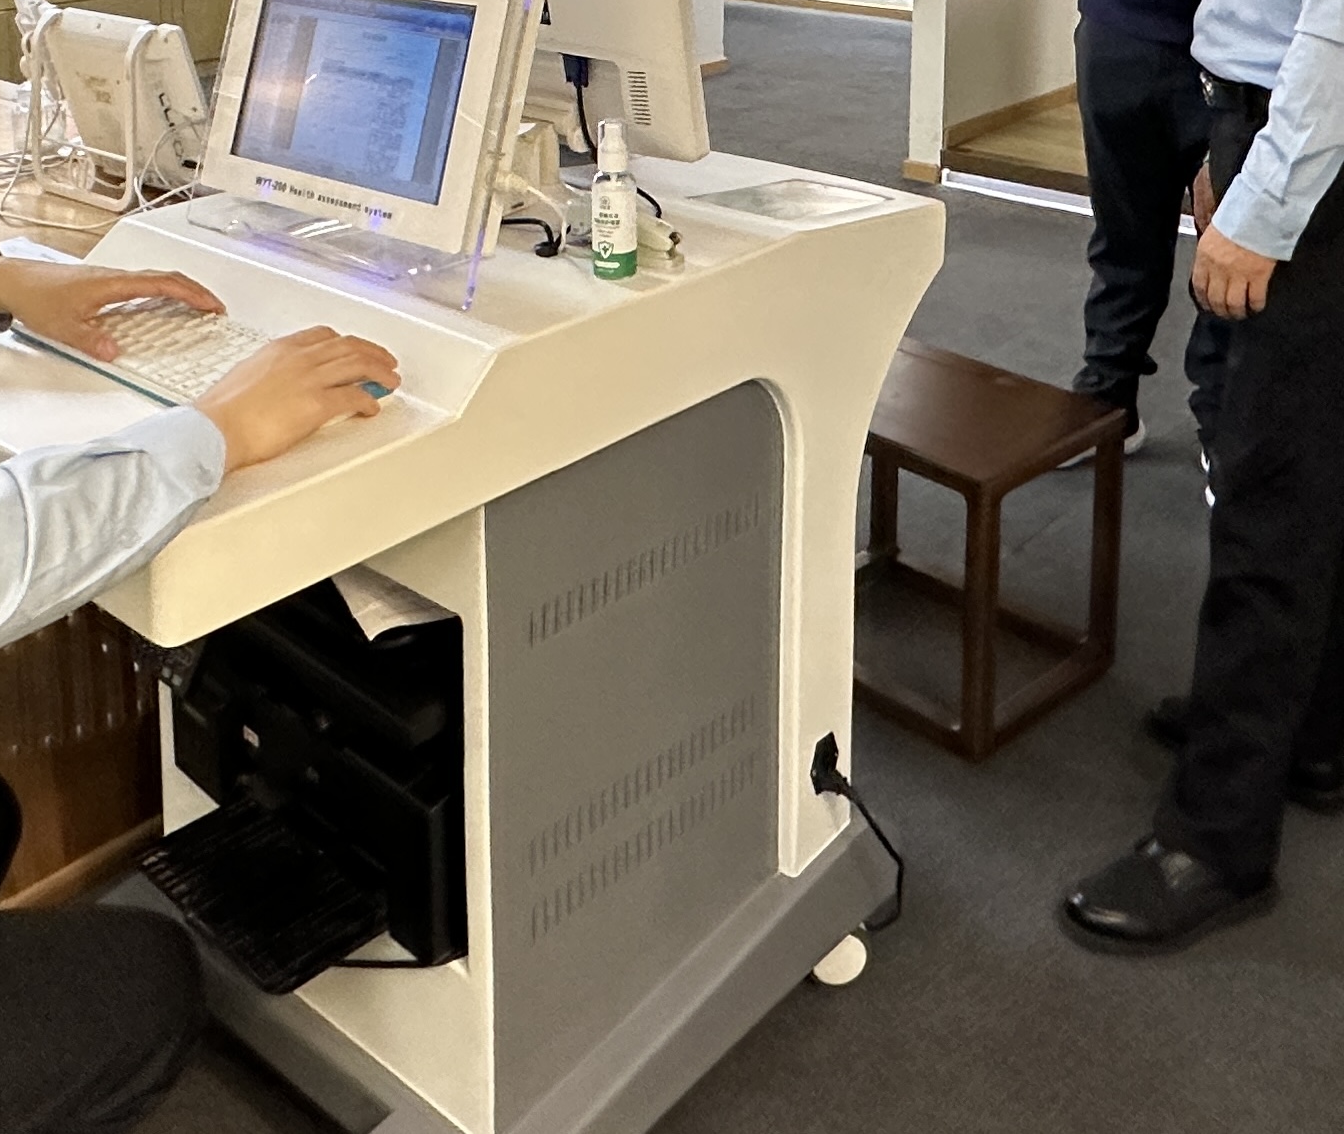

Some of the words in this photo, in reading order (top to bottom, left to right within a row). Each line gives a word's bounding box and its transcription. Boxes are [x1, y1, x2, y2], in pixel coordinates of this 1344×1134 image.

[289, 185, 316, 200] Health
[317, 194, 362, 212] assessment
[363, 206, 393, 220] system
